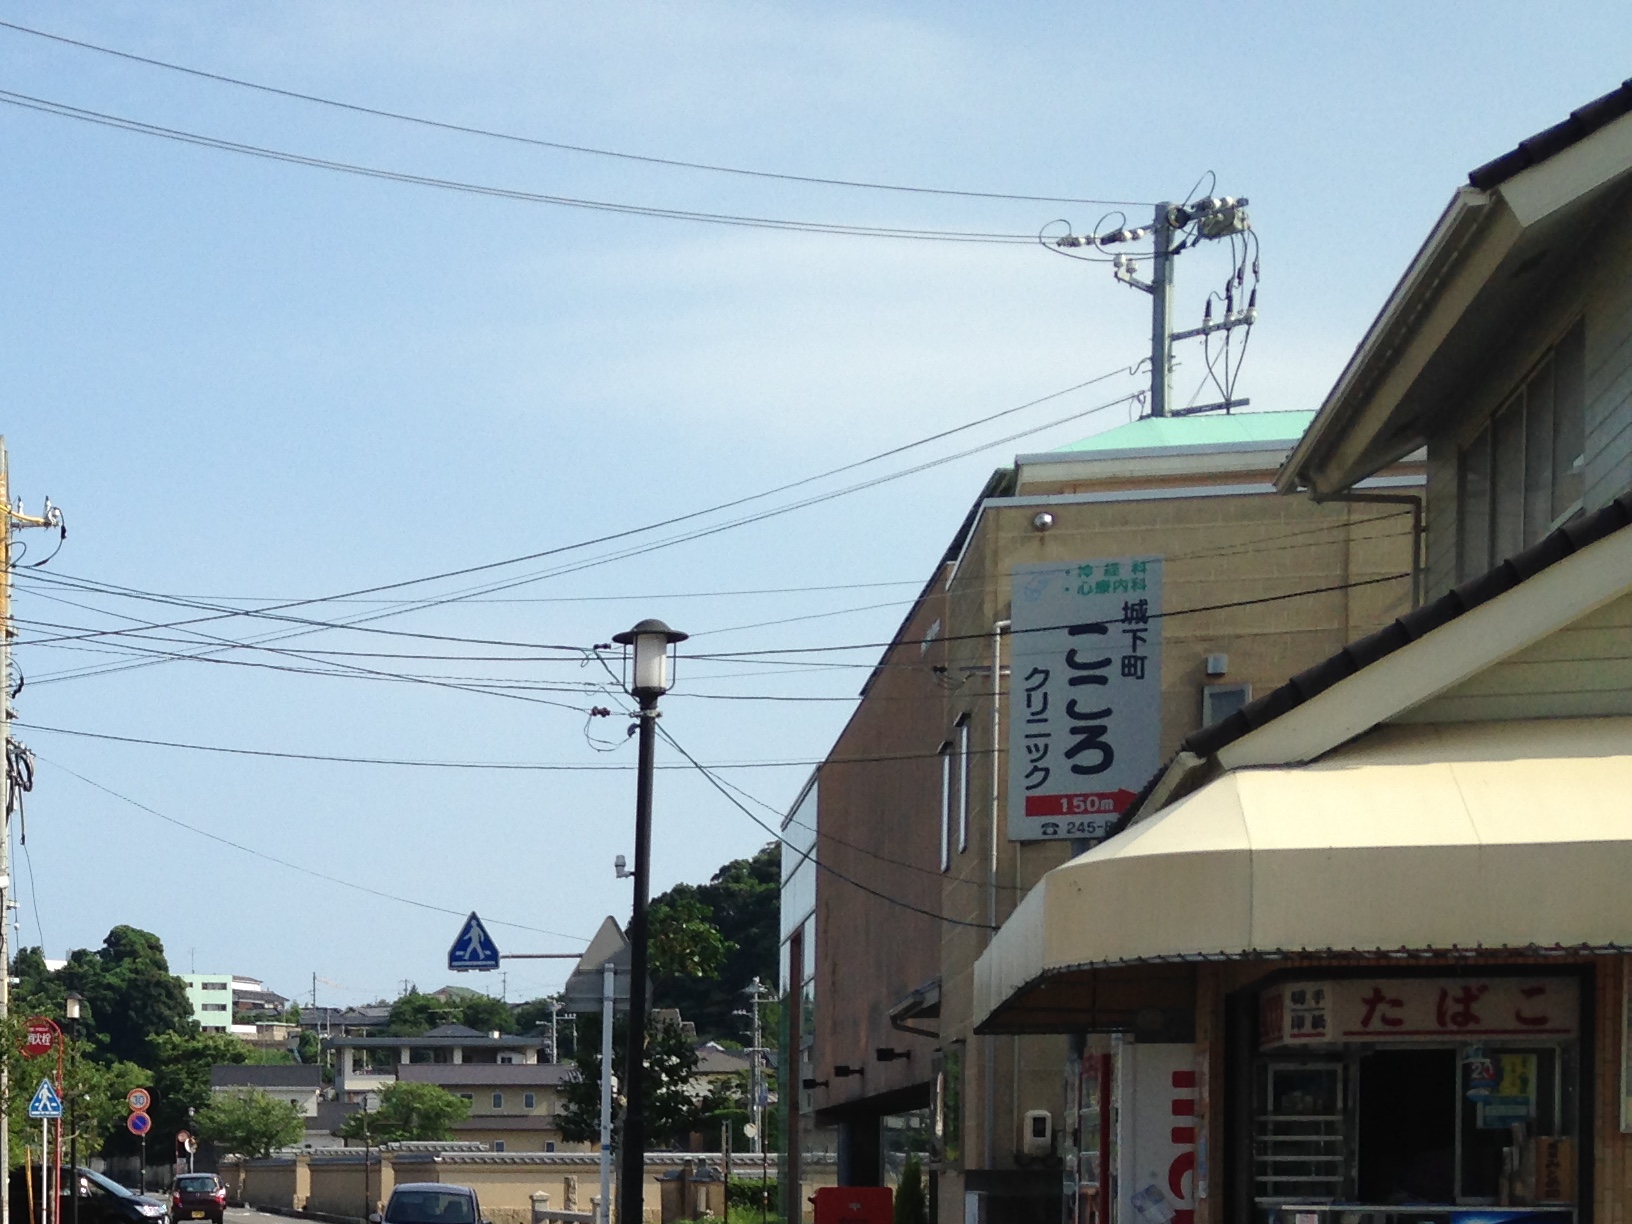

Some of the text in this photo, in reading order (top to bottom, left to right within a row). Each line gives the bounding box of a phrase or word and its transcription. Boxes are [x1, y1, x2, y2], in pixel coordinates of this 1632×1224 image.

[1121, 598, 1149, 680] 城下町
[1024, 666, 1051, 791] クリニック
[1064, 622, 1115, 775] こころ
[1059, 796, 1115, 813] 150m
[1360, 983, 1549, 1028] たばこ
